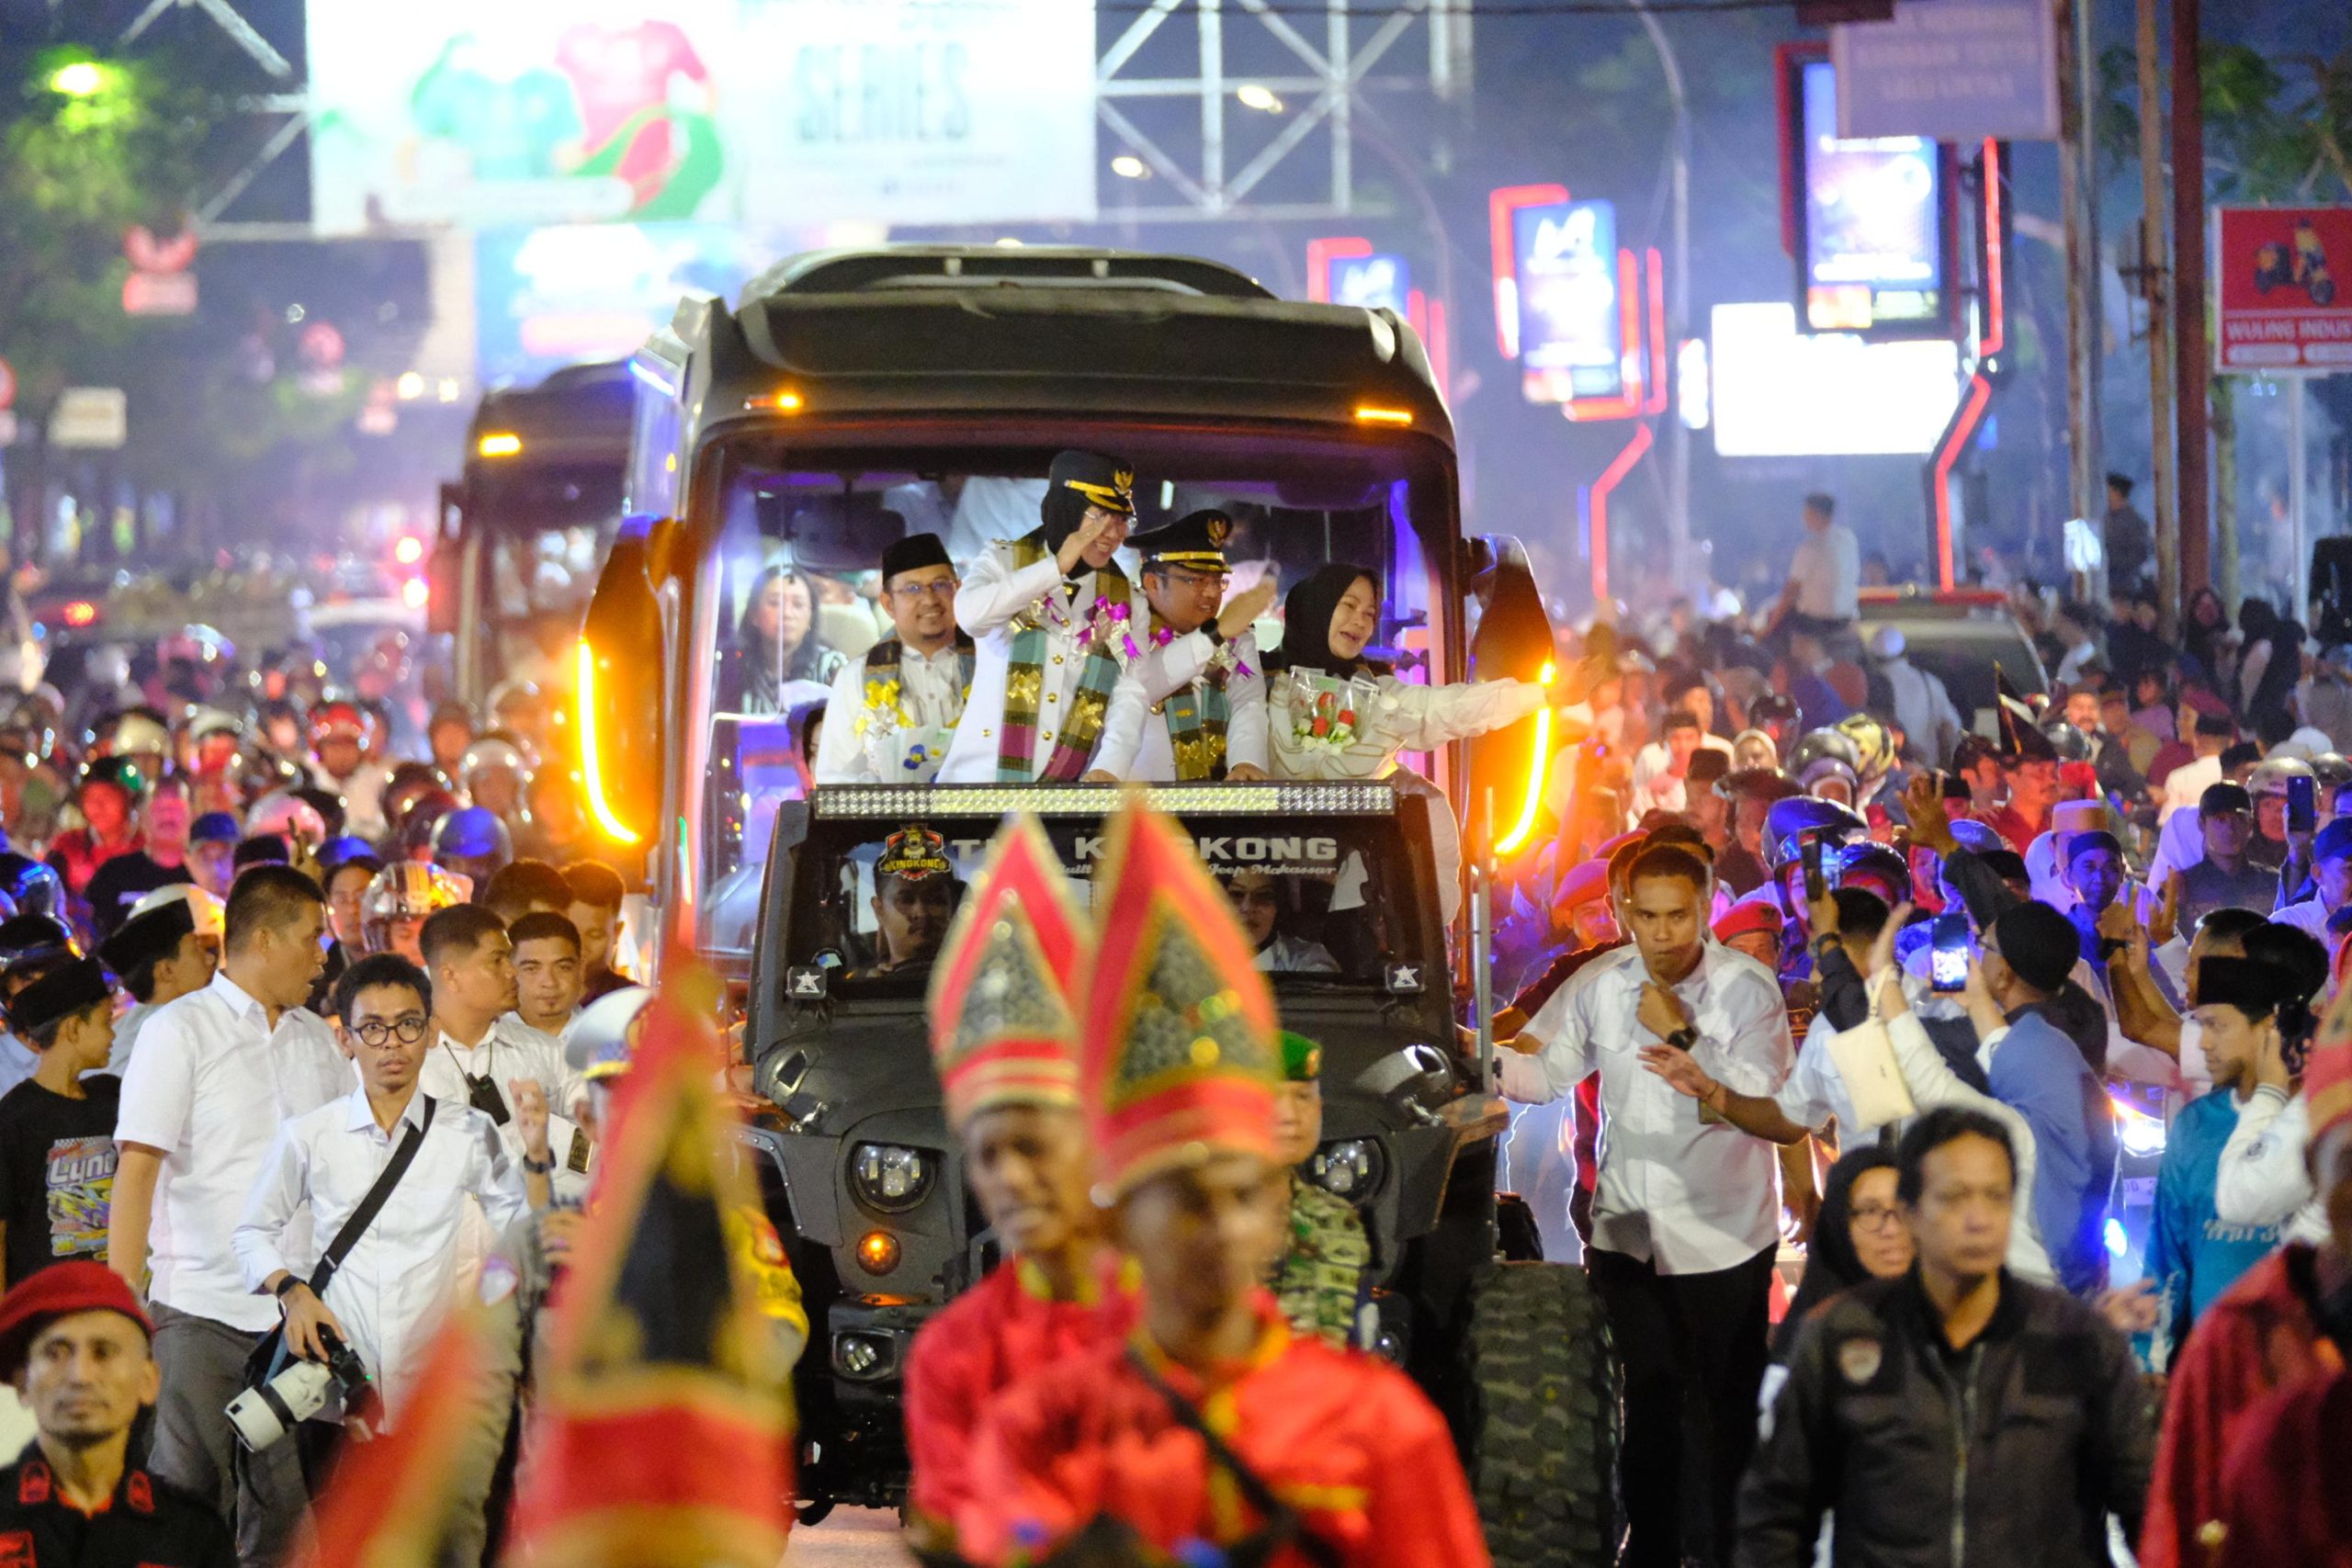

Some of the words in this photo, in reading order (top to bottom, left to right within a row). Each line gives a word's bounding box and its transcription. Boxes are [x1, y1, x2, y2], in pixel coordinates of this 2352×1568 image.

[795, 43, 969, 142] SERIES
[888, 858, 943, 870] KINGKONG
[1208, 863, 1244, 877] Jeep
[1251, 863, 1337, 874] Makassar
